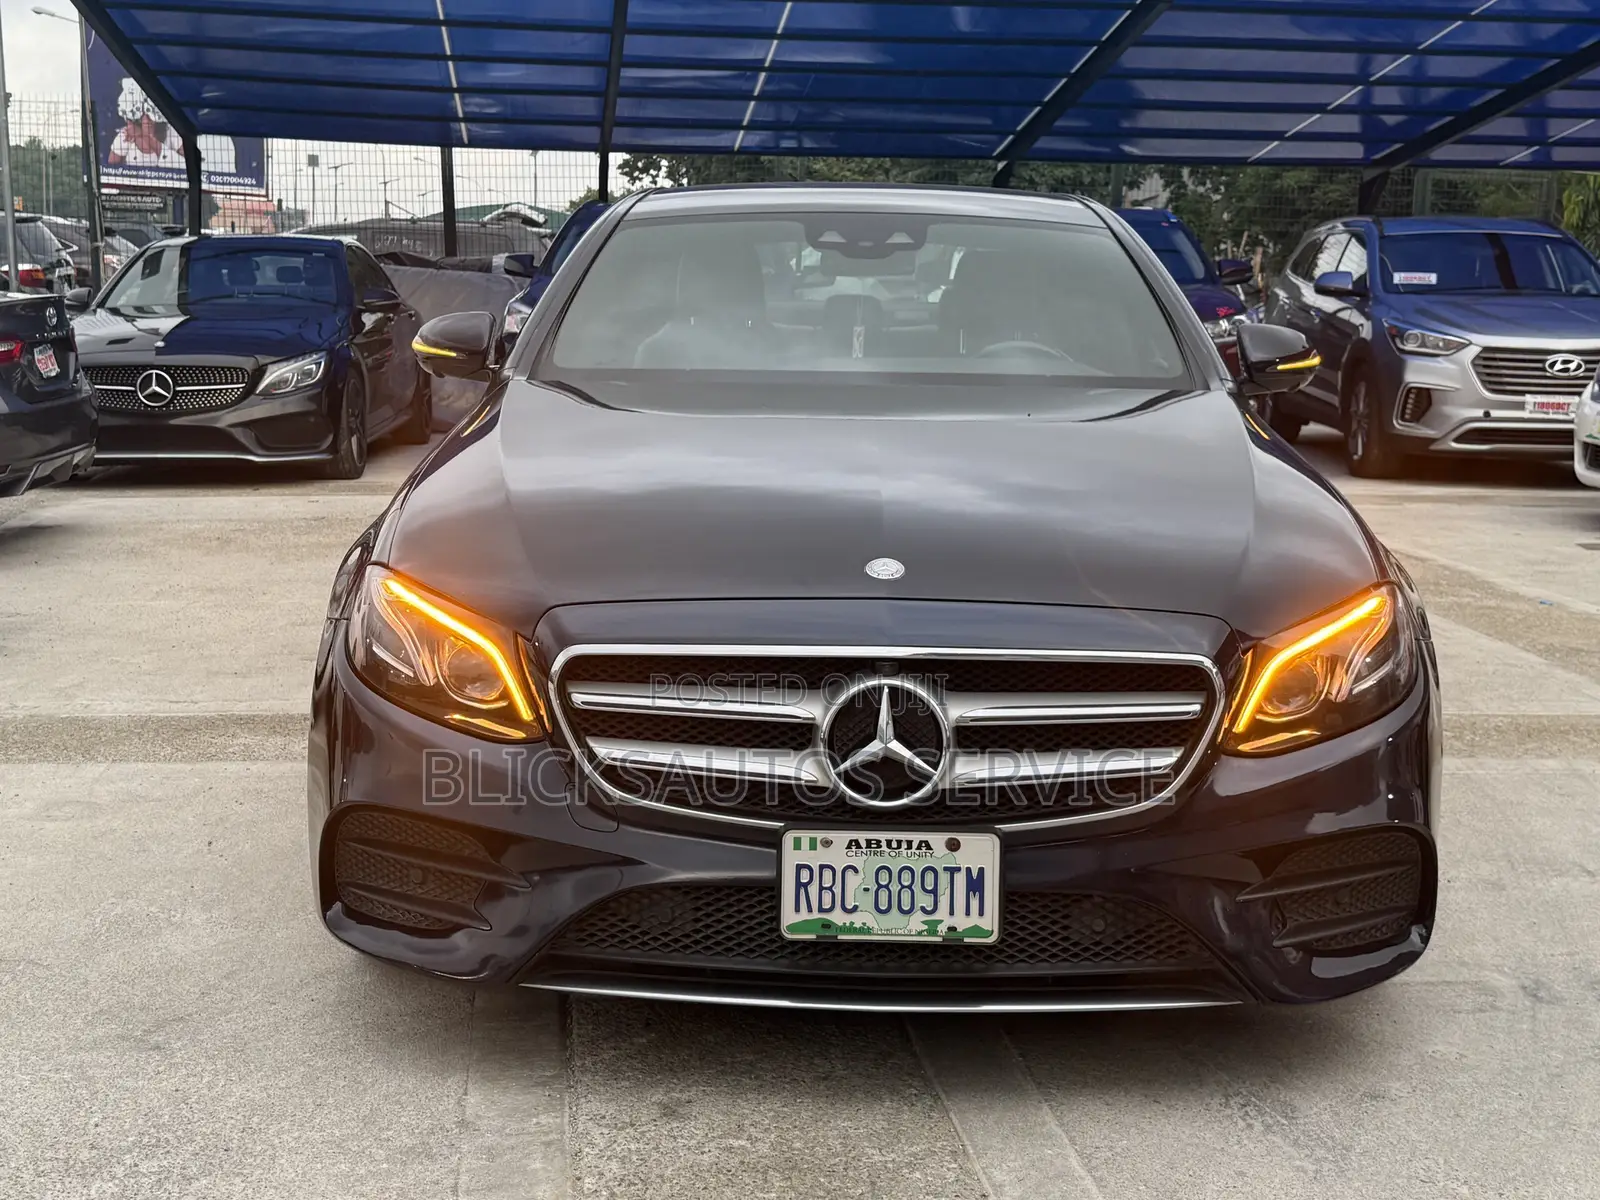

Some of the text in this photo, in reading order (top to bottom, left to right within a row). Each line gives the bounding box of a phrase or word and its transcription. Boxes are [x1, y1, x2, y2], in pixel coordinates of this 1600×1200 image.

[845, 838, 934, 851] ABUJA
[845, 850, 935, 859] CENTRE OF UNITY
[794, 863, 985, 917] RBC-889TM
